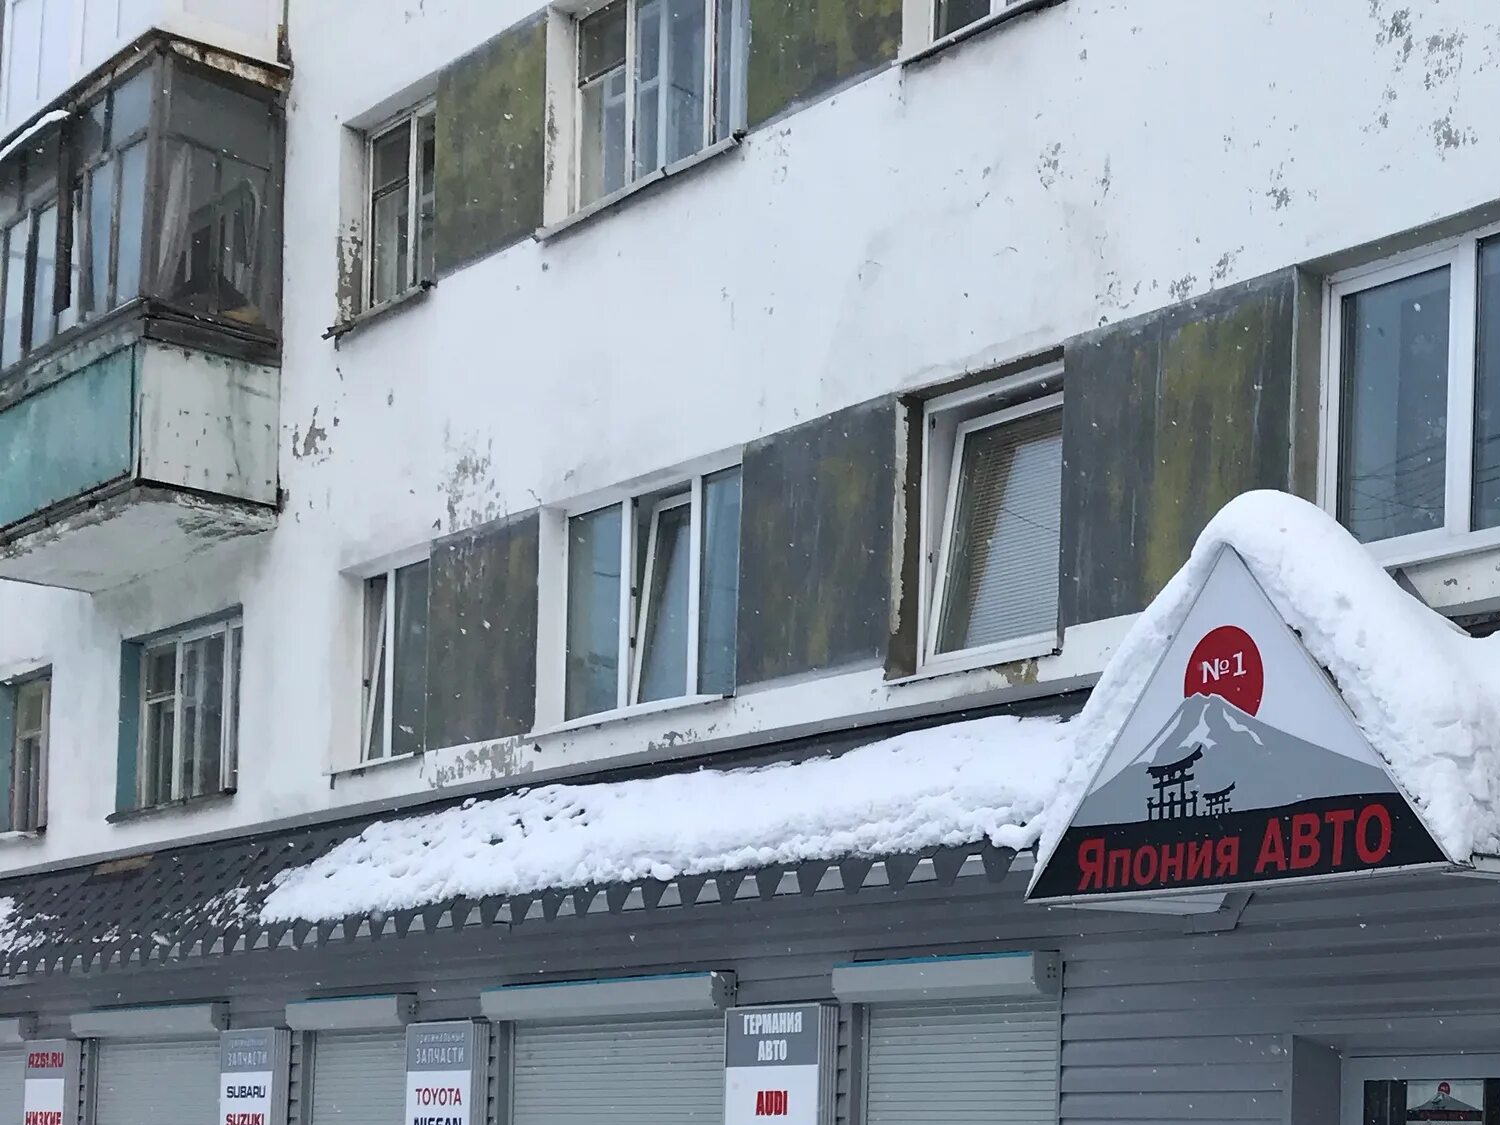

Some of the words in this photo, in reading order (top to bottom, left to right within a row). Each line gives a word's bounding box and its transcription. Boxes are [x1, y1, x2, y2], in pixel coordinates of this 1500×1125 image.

[1077, 836, 1239, 891] Япония
[1254, 804, 1392, 874] АВТО
[743, 1011, 802, 1035] ГЕРМАНИЯ
[228, 1050, 268, 1067] ЗАПЧАСТИ
[416, 1047, 464, 1064] ЗАПЧАСТИ
[757, 1039, 788, 1062] АВТО
[226, 1085, 266, 1098] SUBARU
[415, 1088, 462, 1106] TOYOTA
[756, 1090, 788, 1116] AUDI
